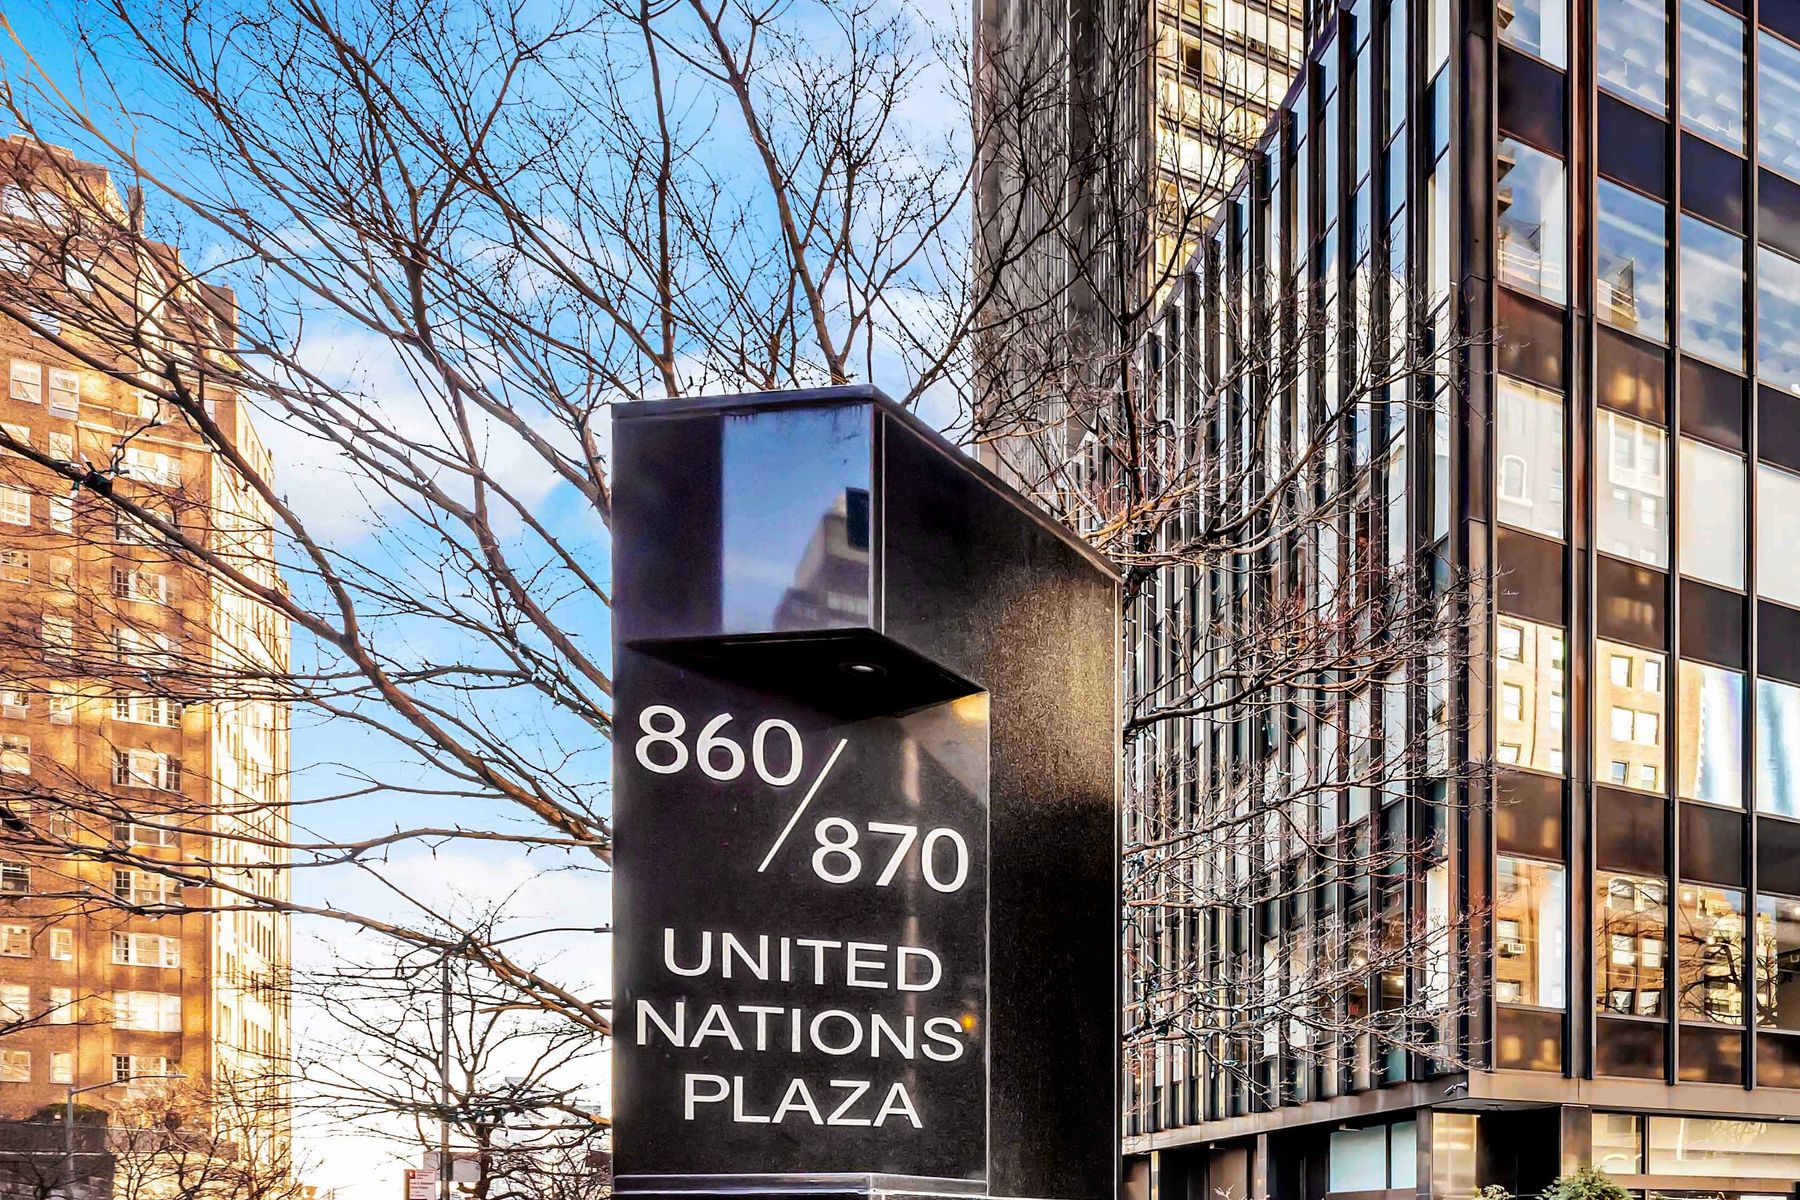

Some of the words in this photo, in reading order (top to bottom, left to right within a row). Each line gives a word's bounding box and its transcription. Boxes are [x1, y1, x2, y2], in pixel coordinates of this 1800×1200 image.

[811, 816, 970, 894] 870
[663, 927, 943, 993] UNITED
[635, 999, 965, 1063] NATIONS
[683, 1072, 924, 1130] PLAZA
